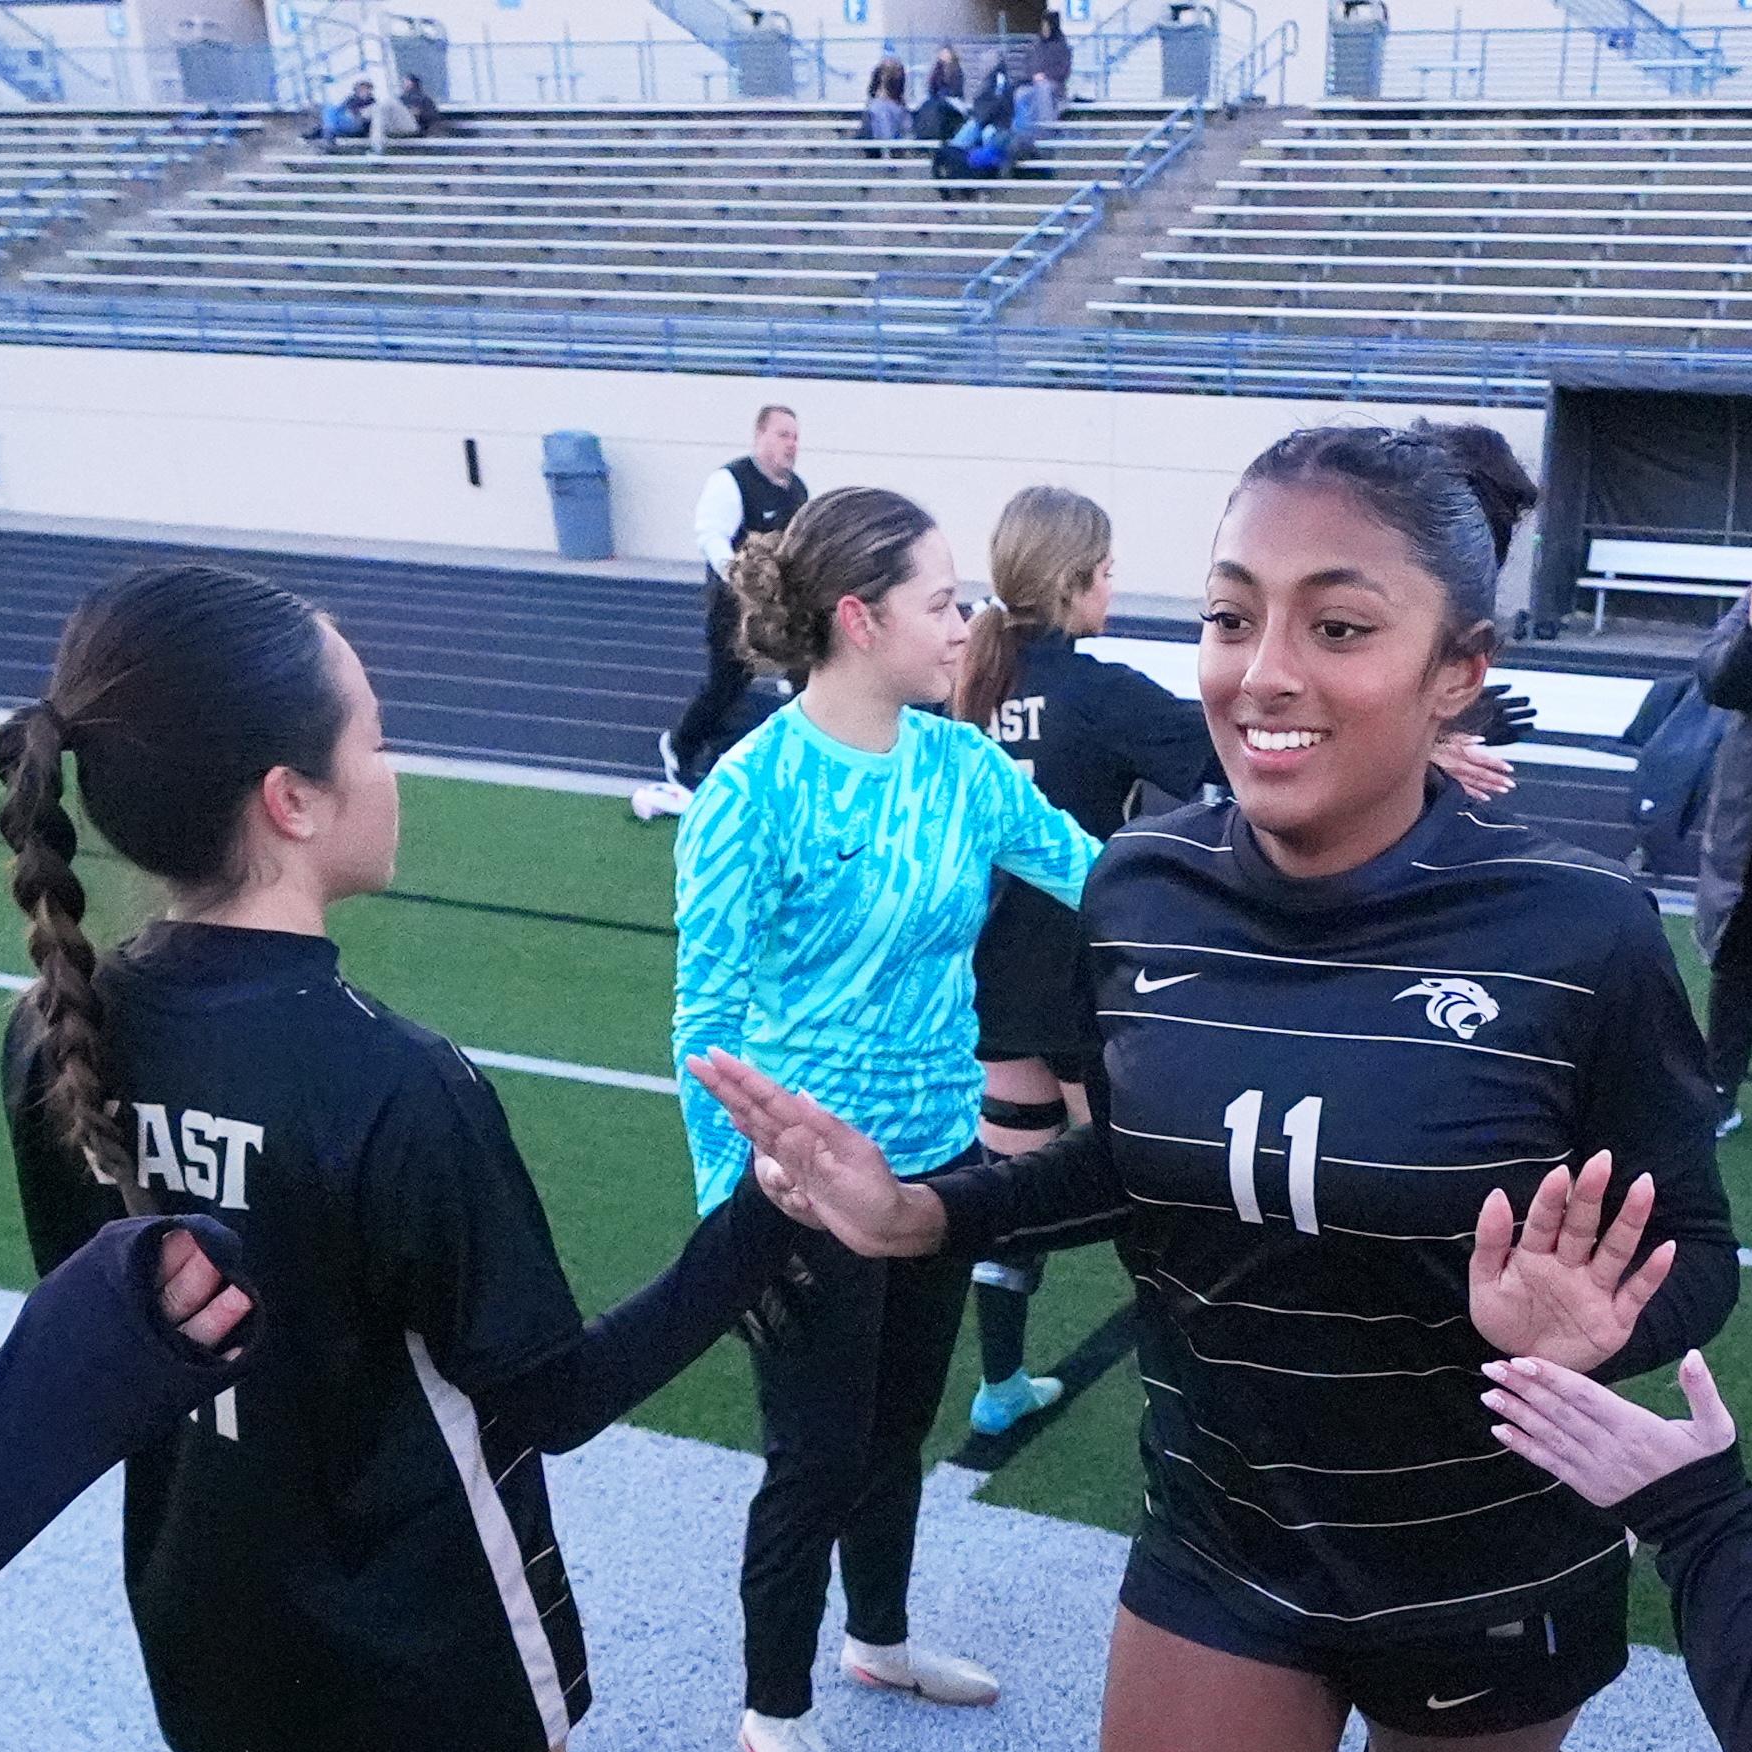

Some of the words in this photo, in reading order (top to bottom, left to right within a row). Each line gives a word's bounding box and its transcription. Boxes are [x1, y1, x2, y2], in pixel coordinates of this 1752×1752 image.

[986, 695, 1046, 743] ST
[83, 1099, 265, 1211] AST
[1223, 1088, 1324, 1236] 11
